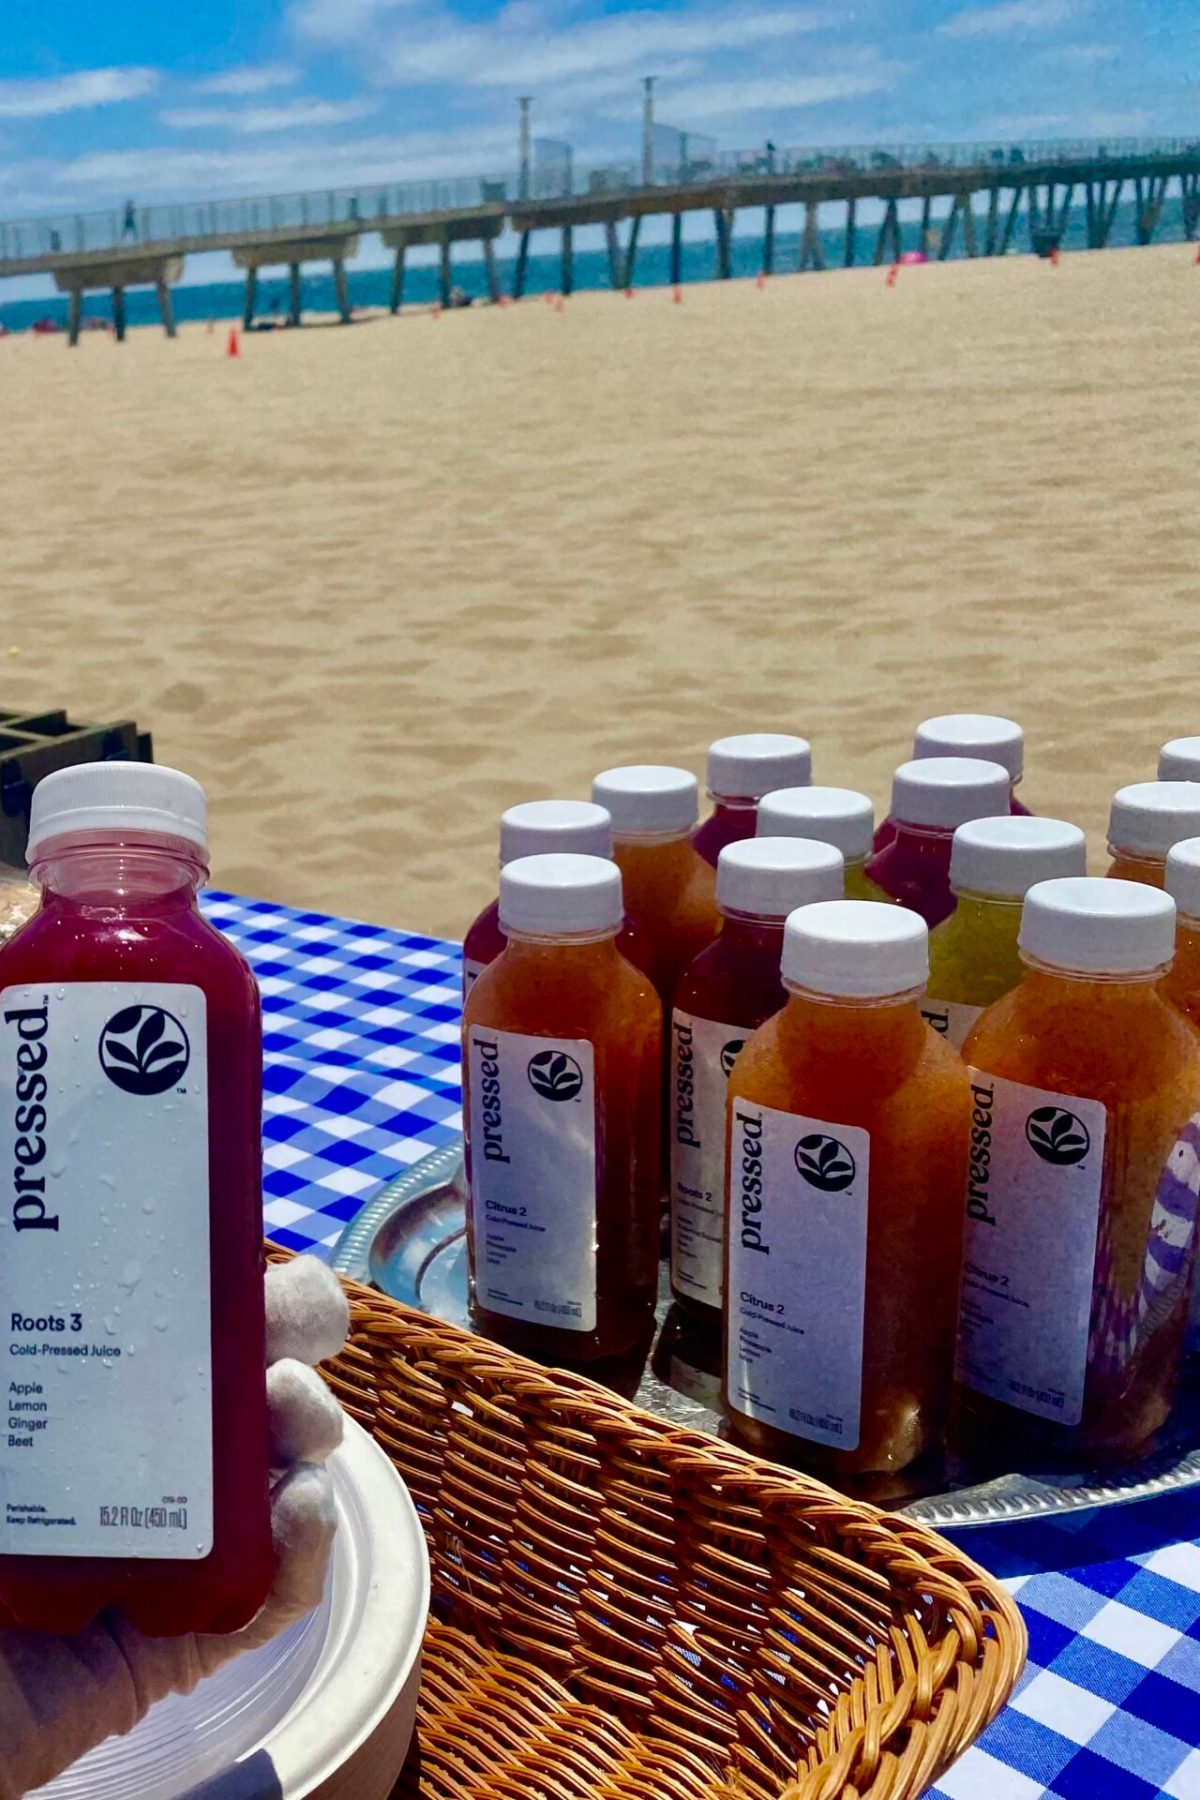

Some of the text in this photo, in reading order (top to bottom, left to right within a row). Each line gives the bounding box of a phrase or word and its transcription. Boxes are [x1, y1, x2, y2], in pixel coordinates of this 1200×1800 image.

[673, 1022, 701, 1149] pressed
[473, 1038, 511, 1165] pressed
[4, 1006, 59, 1233] pressed
[967, 1084, 996, 1227] pressed
[736, 1112, 770, 1256] pressed
[705, 1192, 713, 1202] 2
[485, 1200, 528, 1217] Citrus 2
[1000, 1275, 1010, 1287] 2
[740, 1291, 785, 1315] Citrus 2
[11, 1312, 83, 1332] Roots 3
[9, 1343, 121, 1357] Cold-Pressed Juice
[9, 1381, 44, 1396] Apple
[8, 1400, 48, 1412] Lemon
[8, 1417, 48, 1432] Ginger
[8, 1434, 34, 1447] Beet
[99, 1506, 119, 1527] 15.2
[130, 1506, 143, 1528] Oz
